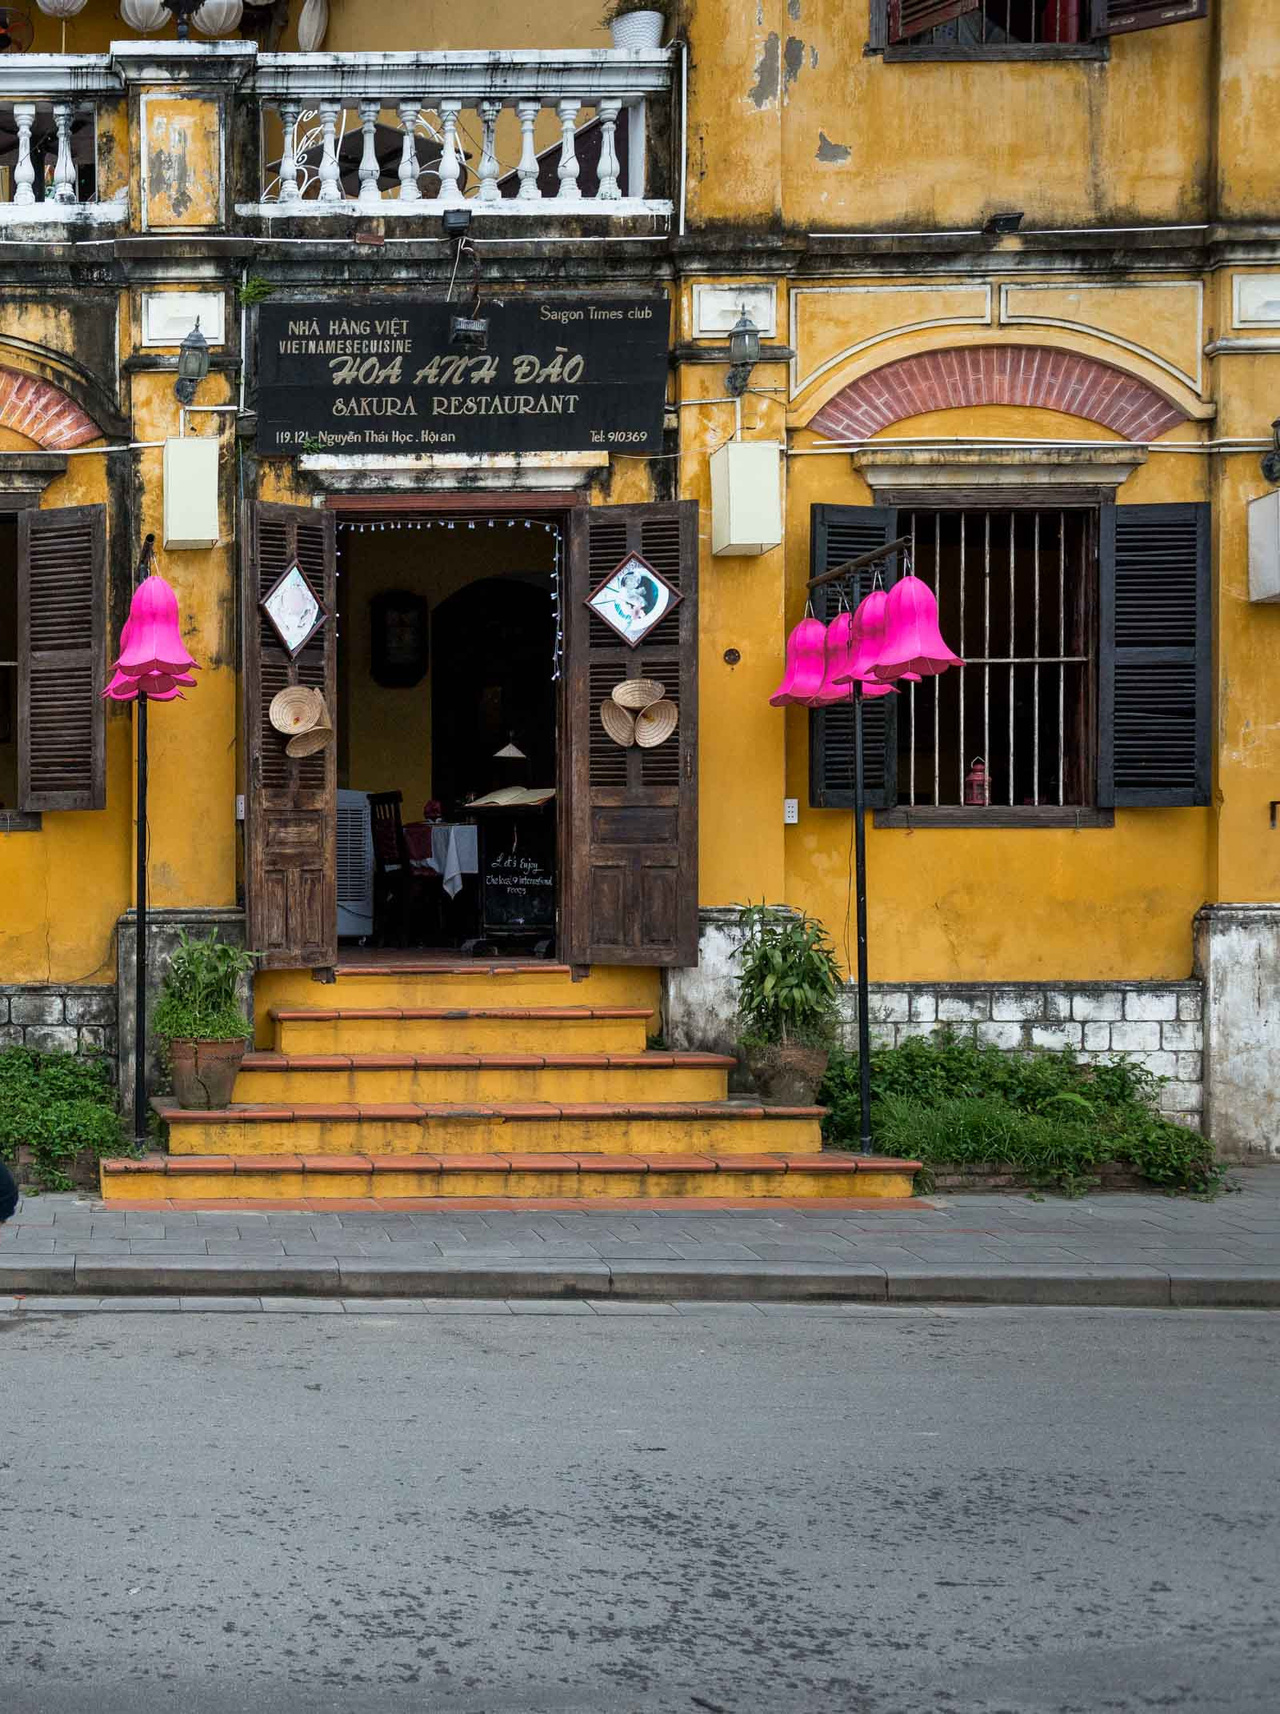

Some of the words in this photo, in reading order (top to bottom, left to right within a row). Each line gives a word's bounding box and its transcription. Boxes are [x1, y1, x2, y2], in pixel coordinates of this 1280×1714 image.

[540, 305, 584, 324] Saigon
[588, 306, 623, 320] Times
[627, 306, 653, 319] club
[288, 317, 320, 335] NHÀ
[329, 317, 371, 335] HÀNG
[374, 317, 410, 338] VIỆT
[328, 355, 403, 385] HOA
[413, 355, 500, 385] ANH
[512, 346, 585, 384] ĐÀO
[332, 396, 419, 417] SAKURA
[432, 394, 580, 416] RESTAURANT
[364, 430, 389, 443] Thái
[589, 429, 606, 443] Tel:
[607, 431, 648, 442] 910369
